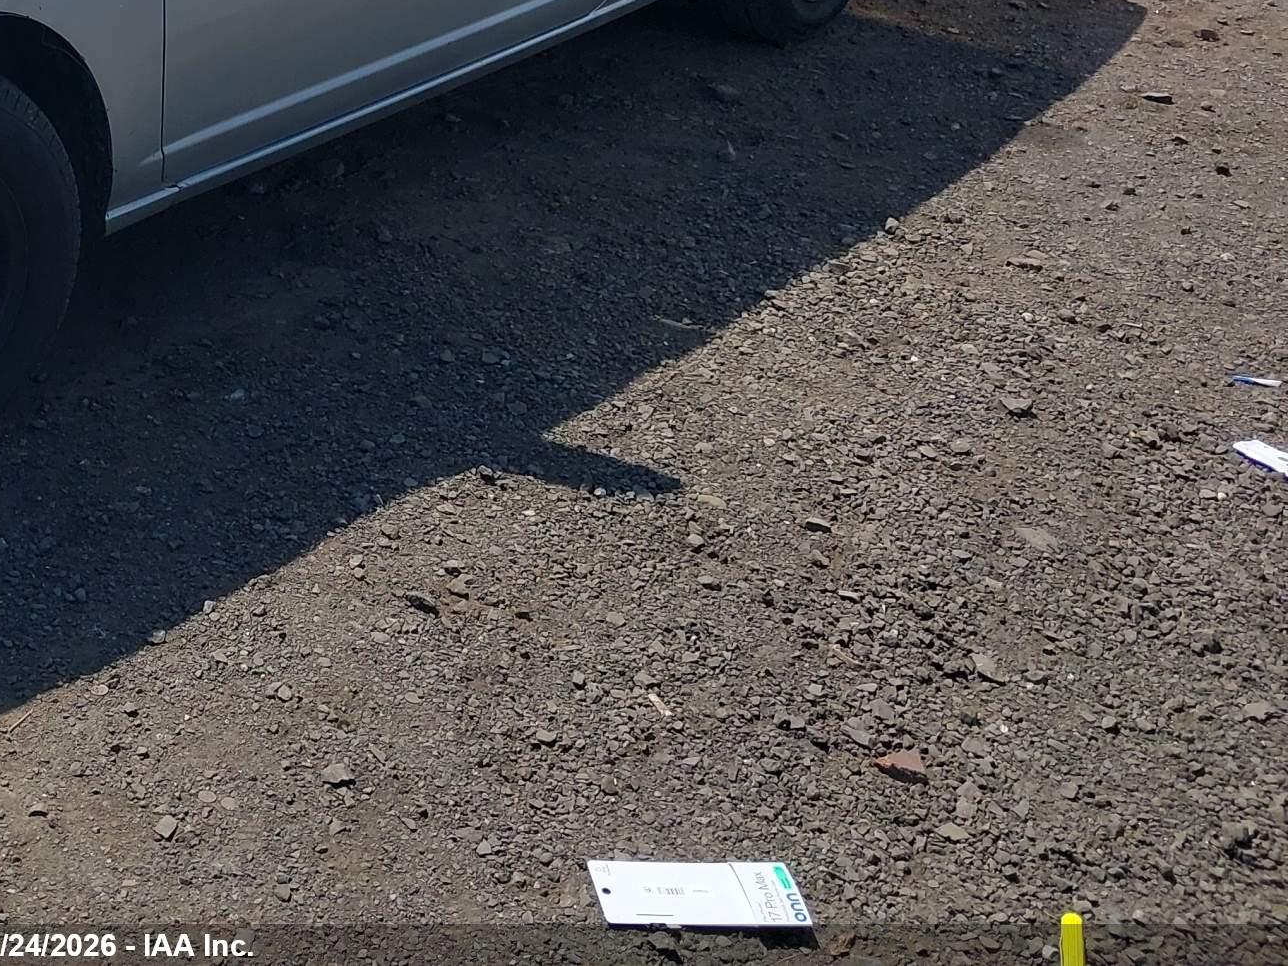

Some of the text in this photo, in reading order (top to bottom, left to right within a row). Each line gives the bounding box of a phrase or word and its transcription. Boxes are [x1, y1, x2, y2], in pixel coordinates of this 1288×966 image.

[753, 871, 770, 891] Max
[764, 891, 778, 909] Pro
[786, 892, 808, 923] onn
[768, 911, 783, 923] 17
